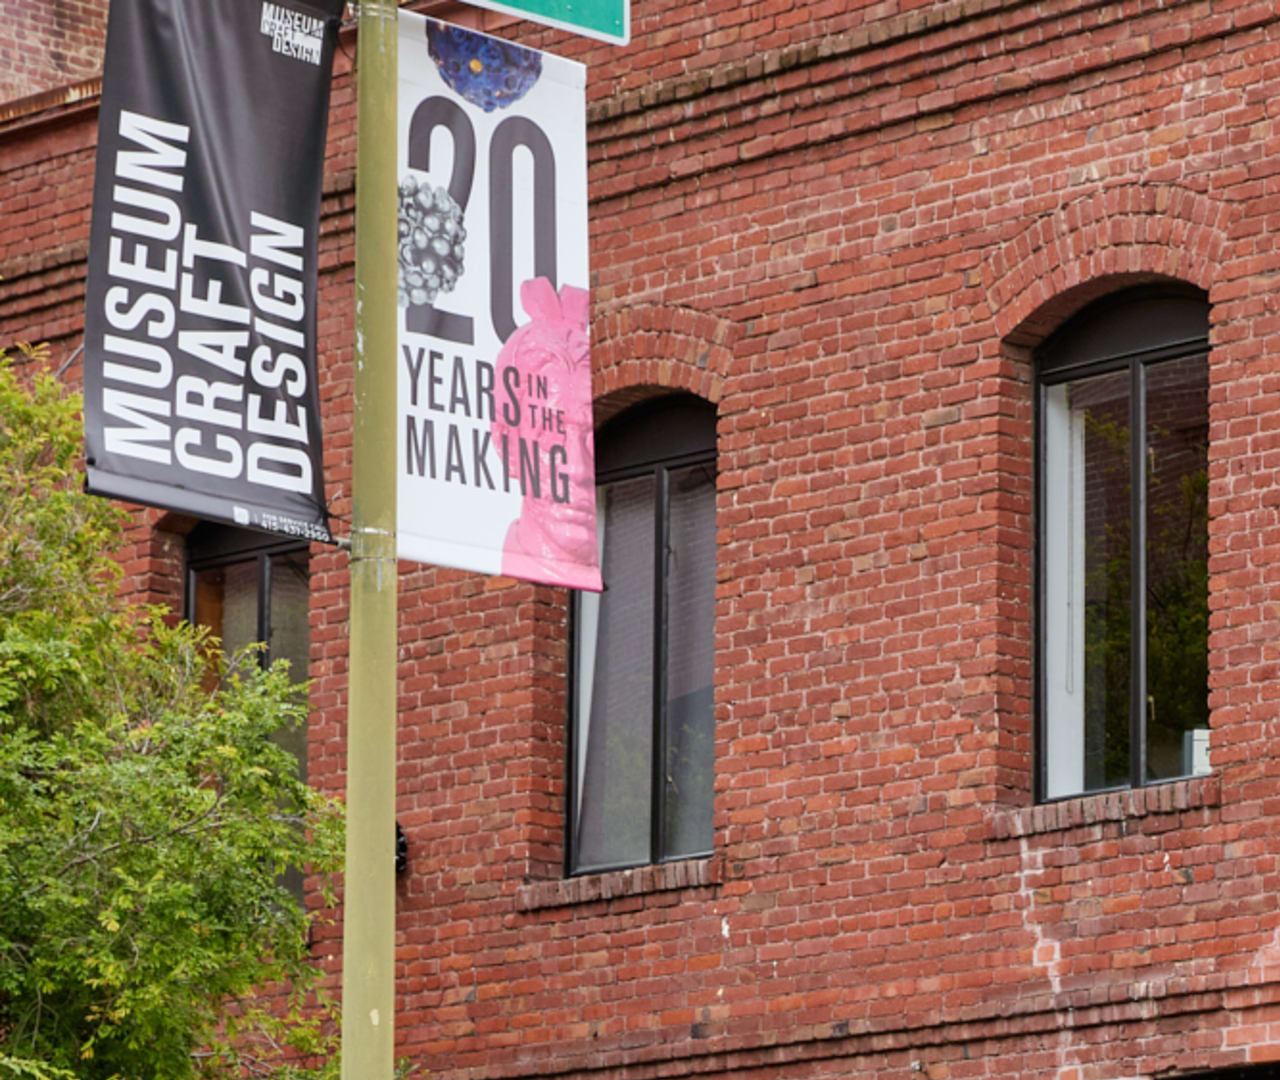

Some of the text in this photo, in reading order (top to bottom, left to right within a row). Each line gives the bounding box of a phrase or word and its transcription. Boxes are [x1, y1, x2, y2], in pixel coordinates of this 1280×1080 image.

[261, 1, 324, 39] MUSEUM
[103, 110, 190, 465] MUSEUM
[406, 95, 558, 346] 20
[174, 222, 251, 480] CRAFT
[247, 210, 312, 494] DESIGN
[402, 344, 548, 428] YEARS IN
[528, 404, 566, 435] THE
[407, 414, 570, 504] MAKING
